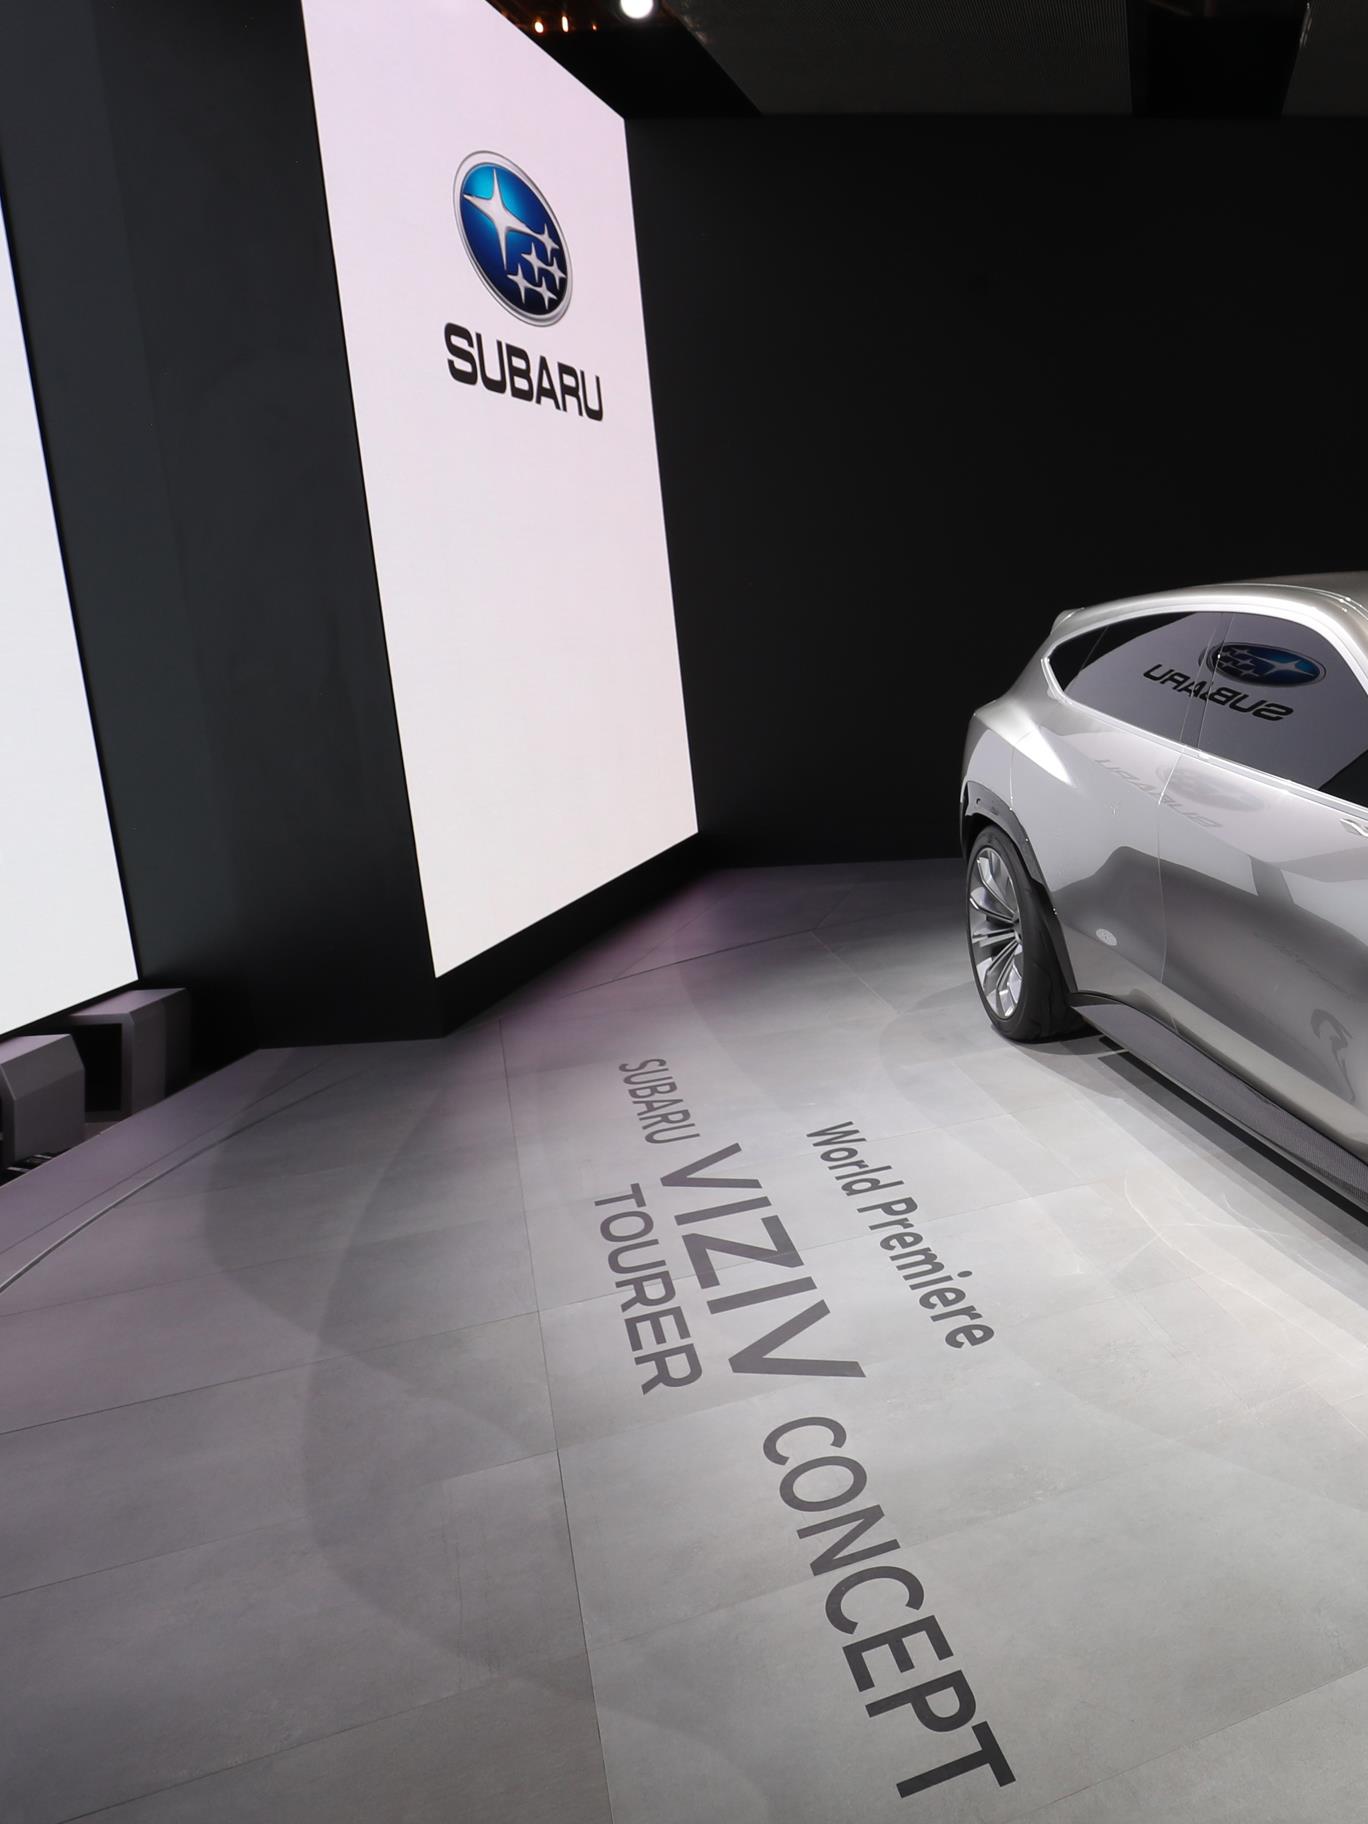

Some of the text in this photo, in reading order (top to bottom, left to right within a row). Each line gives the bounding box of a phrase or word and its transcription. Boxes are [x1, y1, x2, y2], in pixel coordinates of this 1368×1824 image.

[444, 322, 603, 422] SUBARU
[594, 1182, 702, 1395] TOURER
[805, 1121, 995, 1349] World Premiere
[618, 1058, 1016, 1799] SUBARU VIZIV CONCEPT
